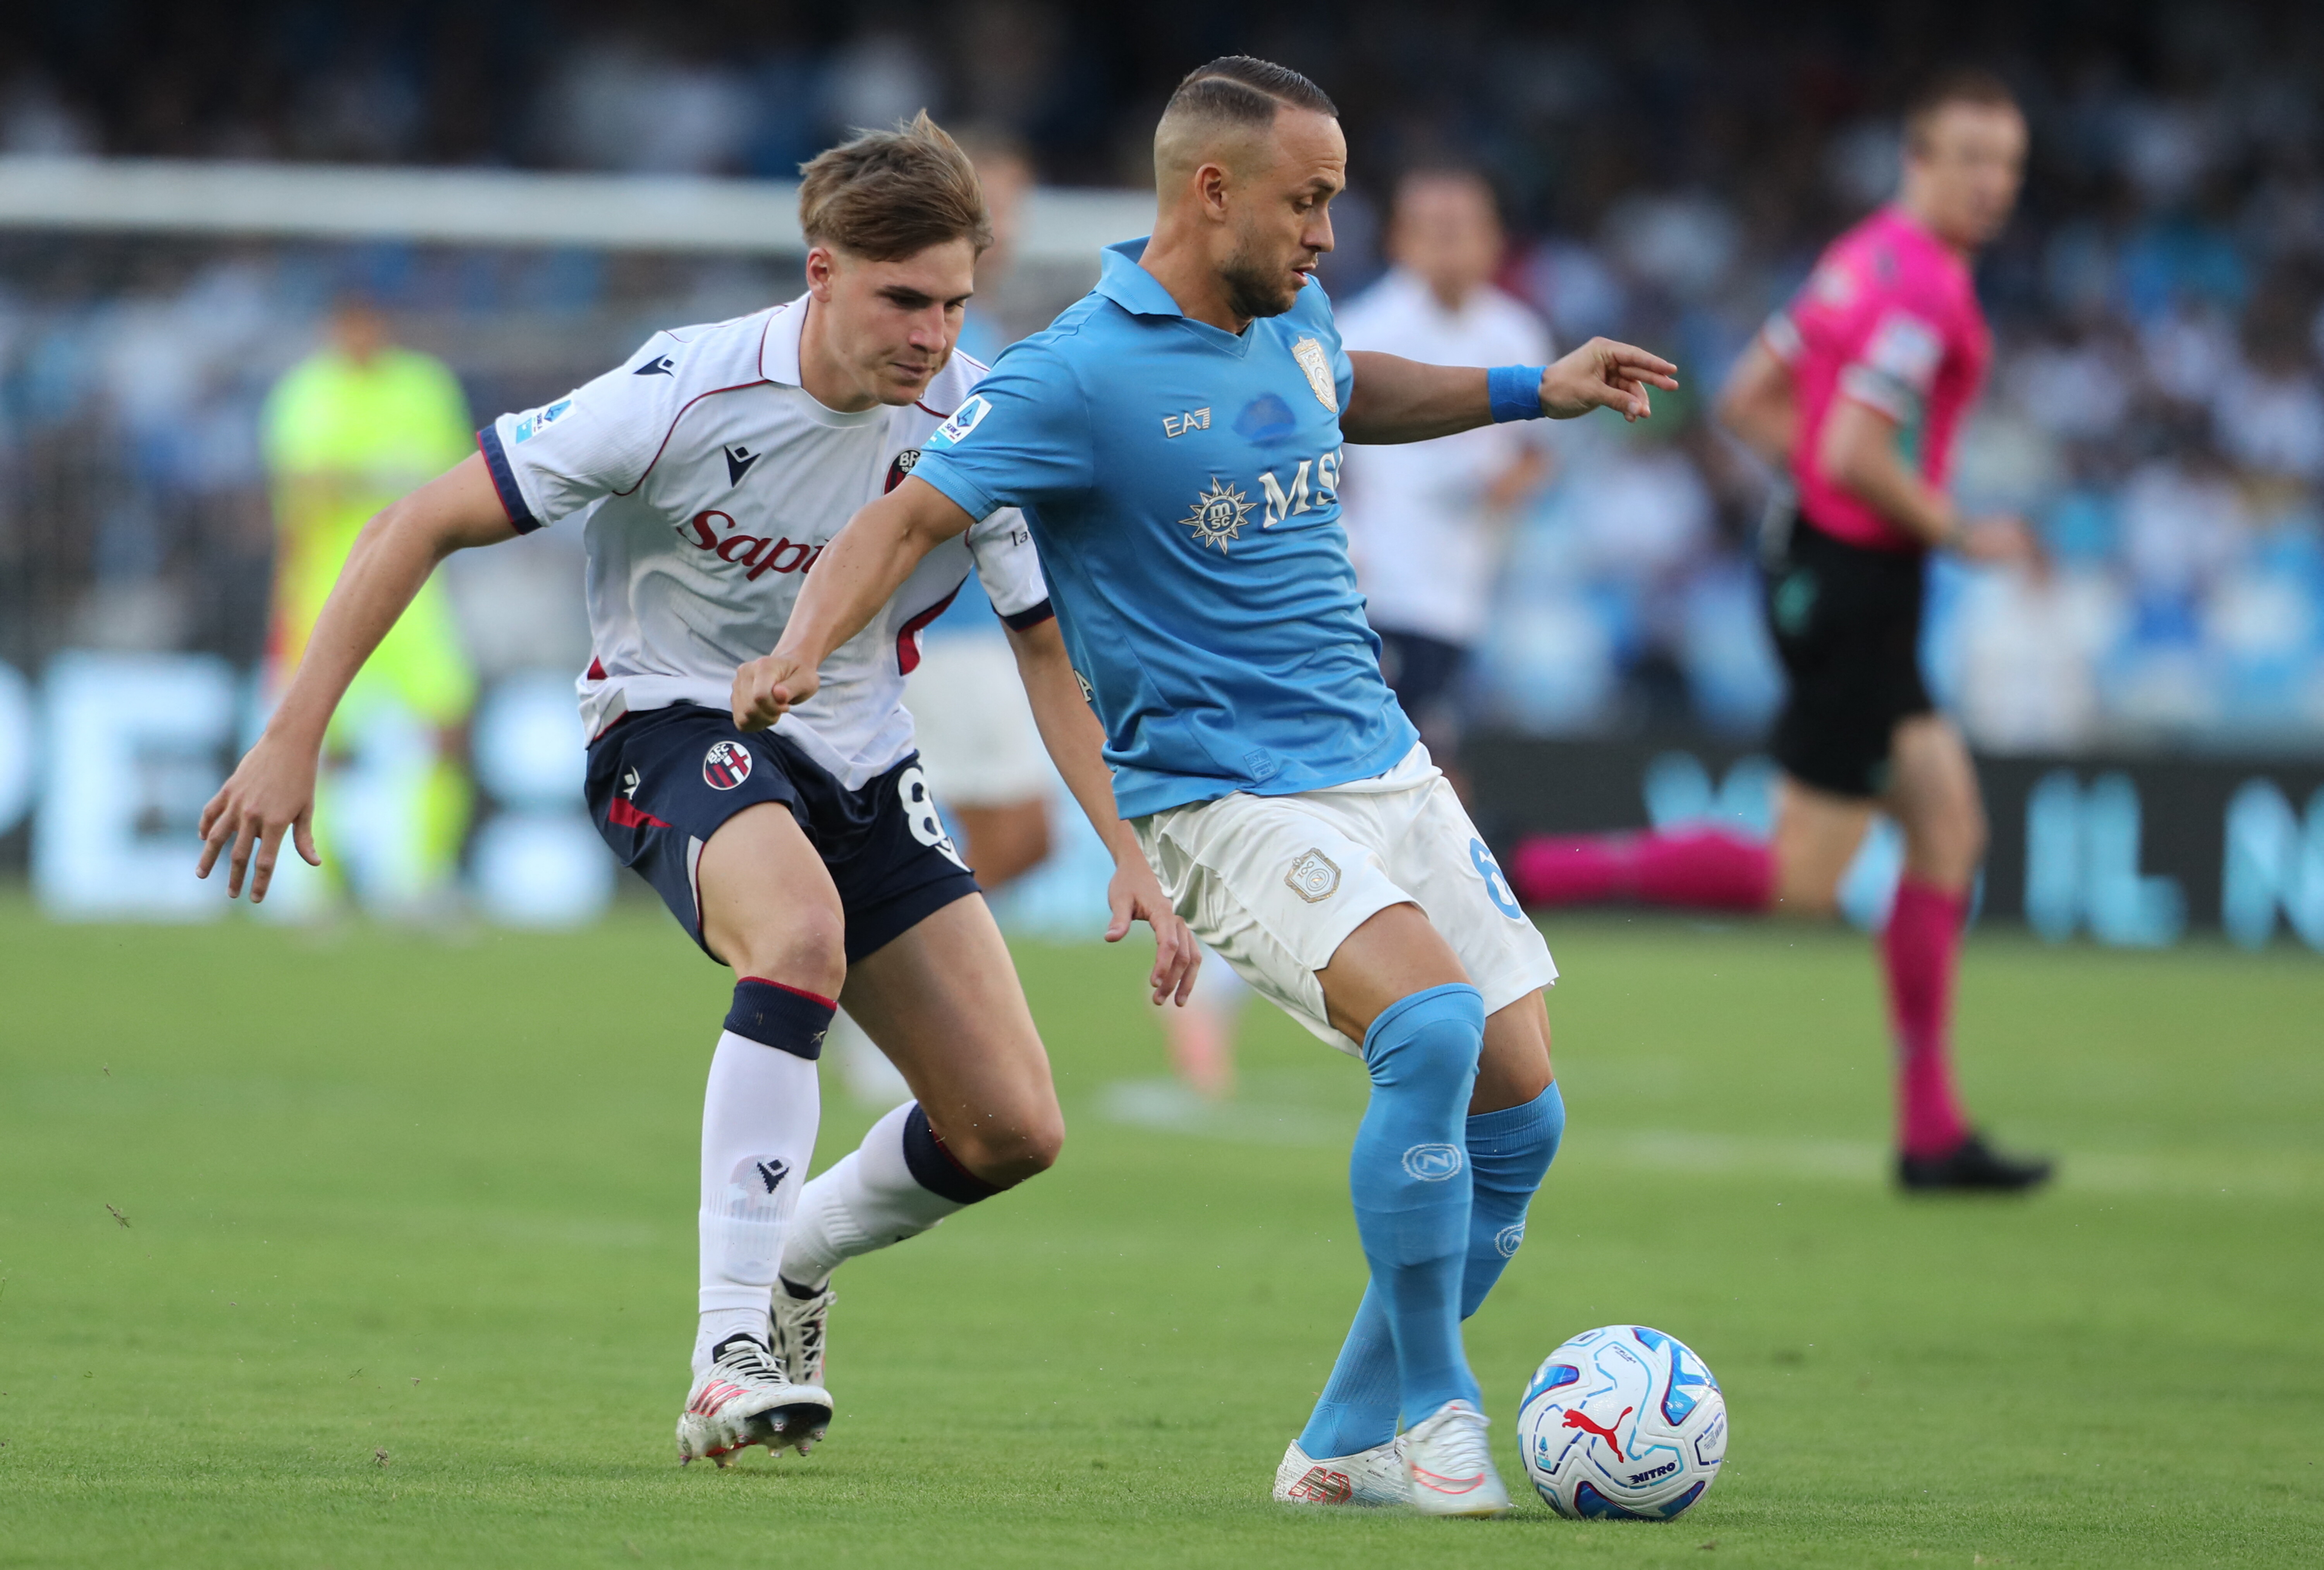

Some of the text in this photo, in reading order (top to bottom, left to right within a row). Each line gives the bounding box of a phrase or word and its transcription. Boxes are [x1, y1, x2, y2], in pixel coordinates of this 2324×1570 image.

[1162, 407, 1210, 438] EA7
[708, 744, 729, 764] BFC
[1470, 837, 1521, 919] 6
[1420, 1153, 1450, 1169] N
[1626, 1462, 1676, 1485] NITRO
